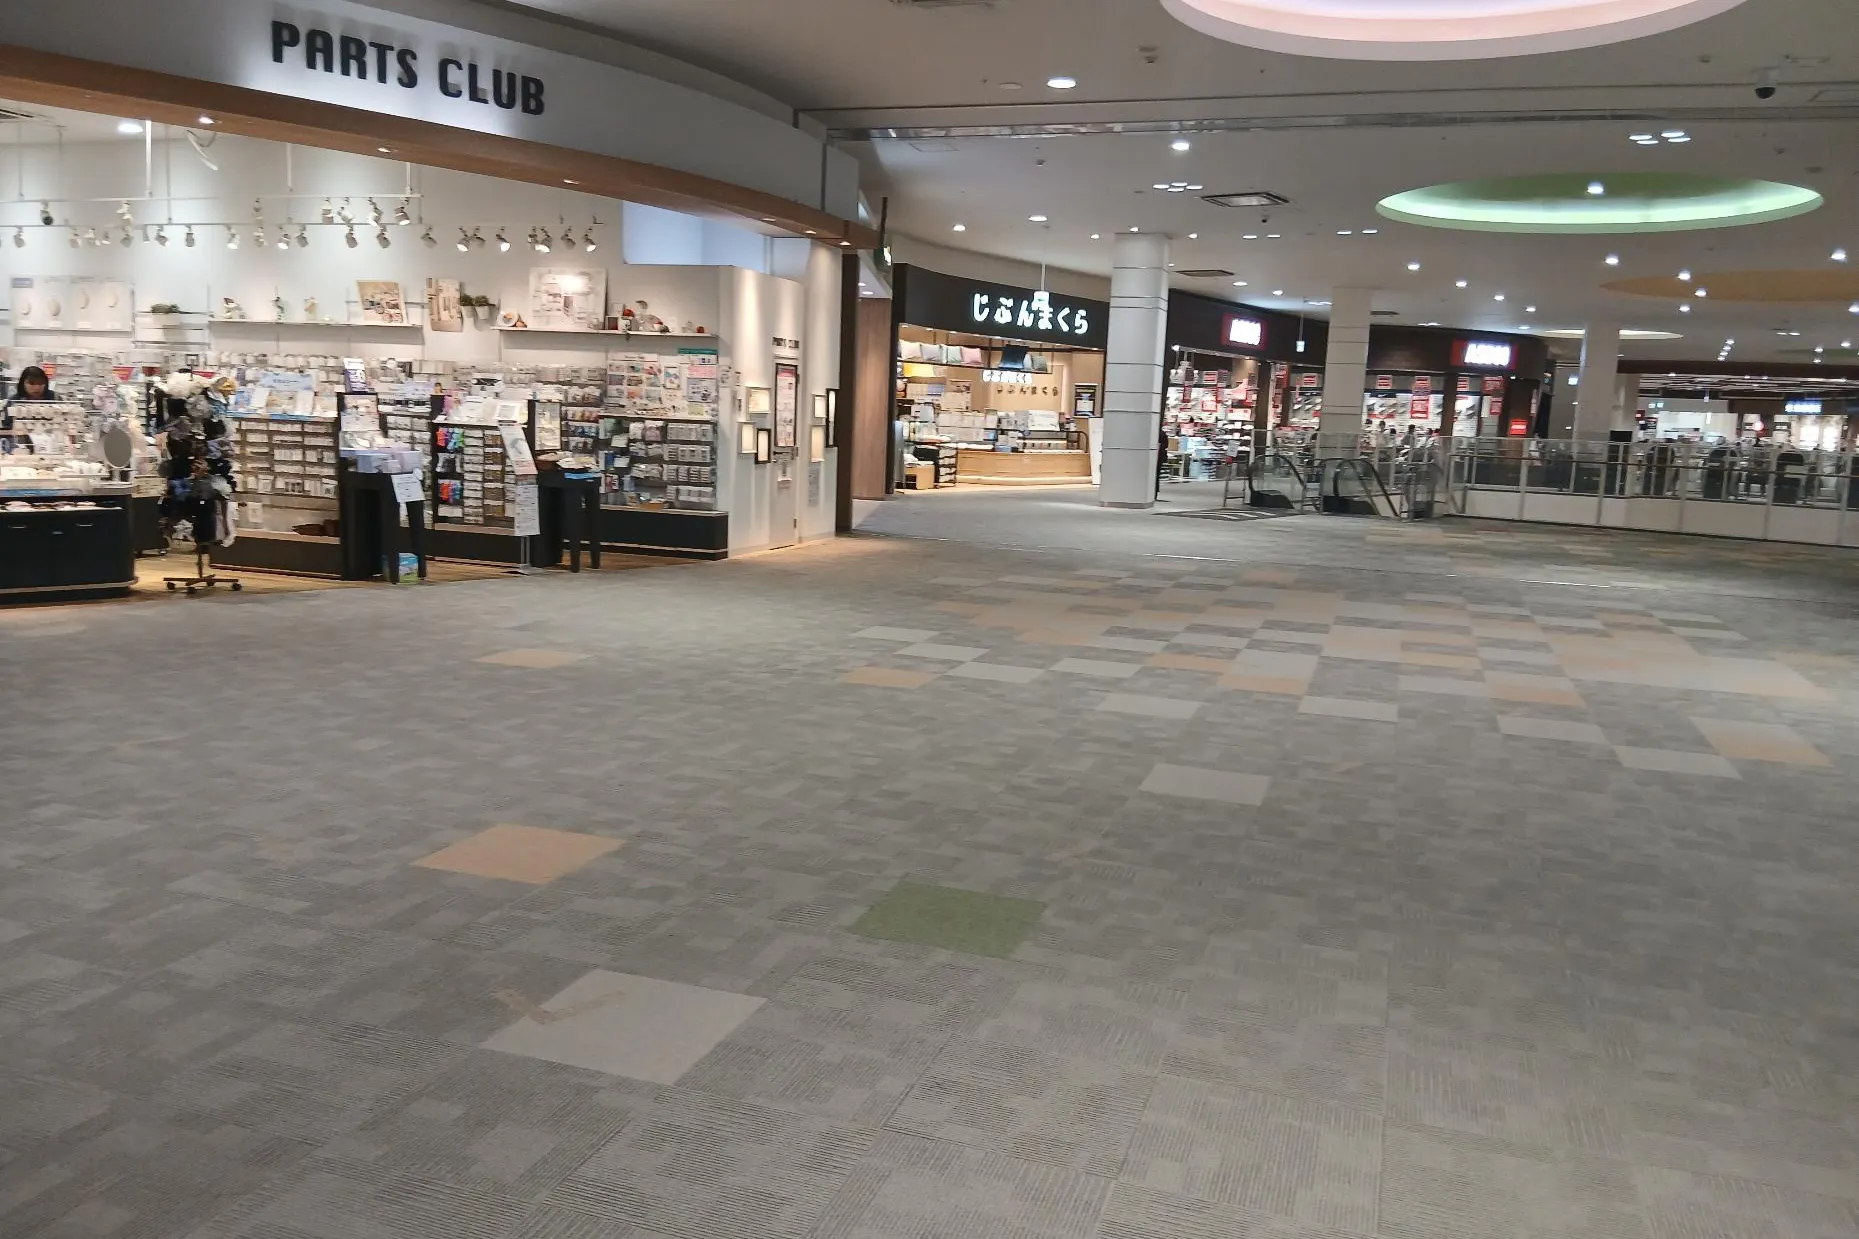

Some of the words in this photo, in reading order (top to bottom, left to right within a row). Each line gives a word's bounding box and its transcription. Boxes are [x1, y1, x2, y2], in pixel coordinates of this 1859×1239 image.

[271, 19, 418, 88] PARTS
[438, 57, 546, 116] CLUB
[973, 292, 1090, 335] じぶんまくら
